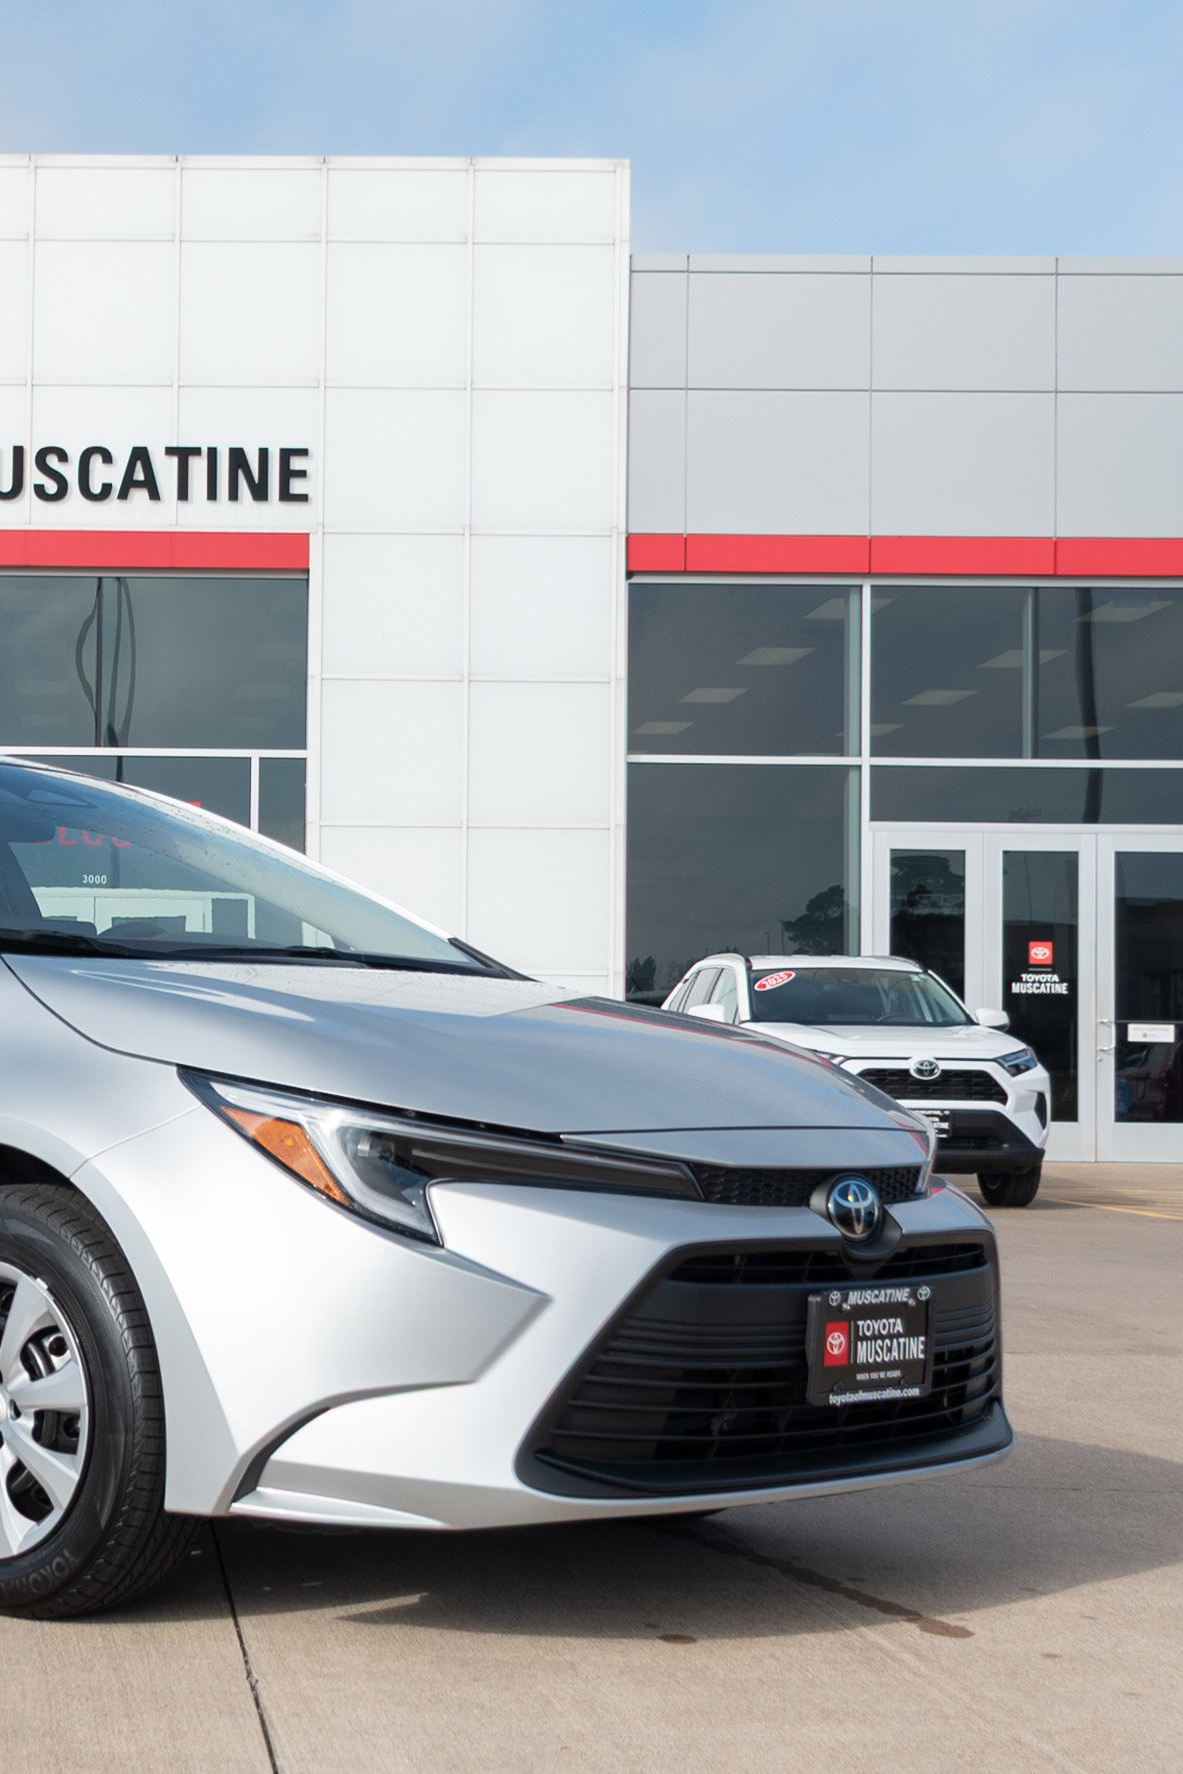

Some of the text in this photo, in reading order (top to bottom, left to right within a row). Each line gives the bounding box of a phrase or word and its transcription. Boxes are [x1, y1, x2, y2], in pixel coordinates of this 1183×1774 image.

[82, 873, 107, 885] 3000
[1020, 973, 1060, 983] TOYOTA
[1011, 982, 1069, 995] MUSCATINE
[848, 1288, 910, 1305] MUSCATINE
[857, 1317, 903, 1336] TOYOTA
[857, 1336, 925, 1364] MUSCATINE
